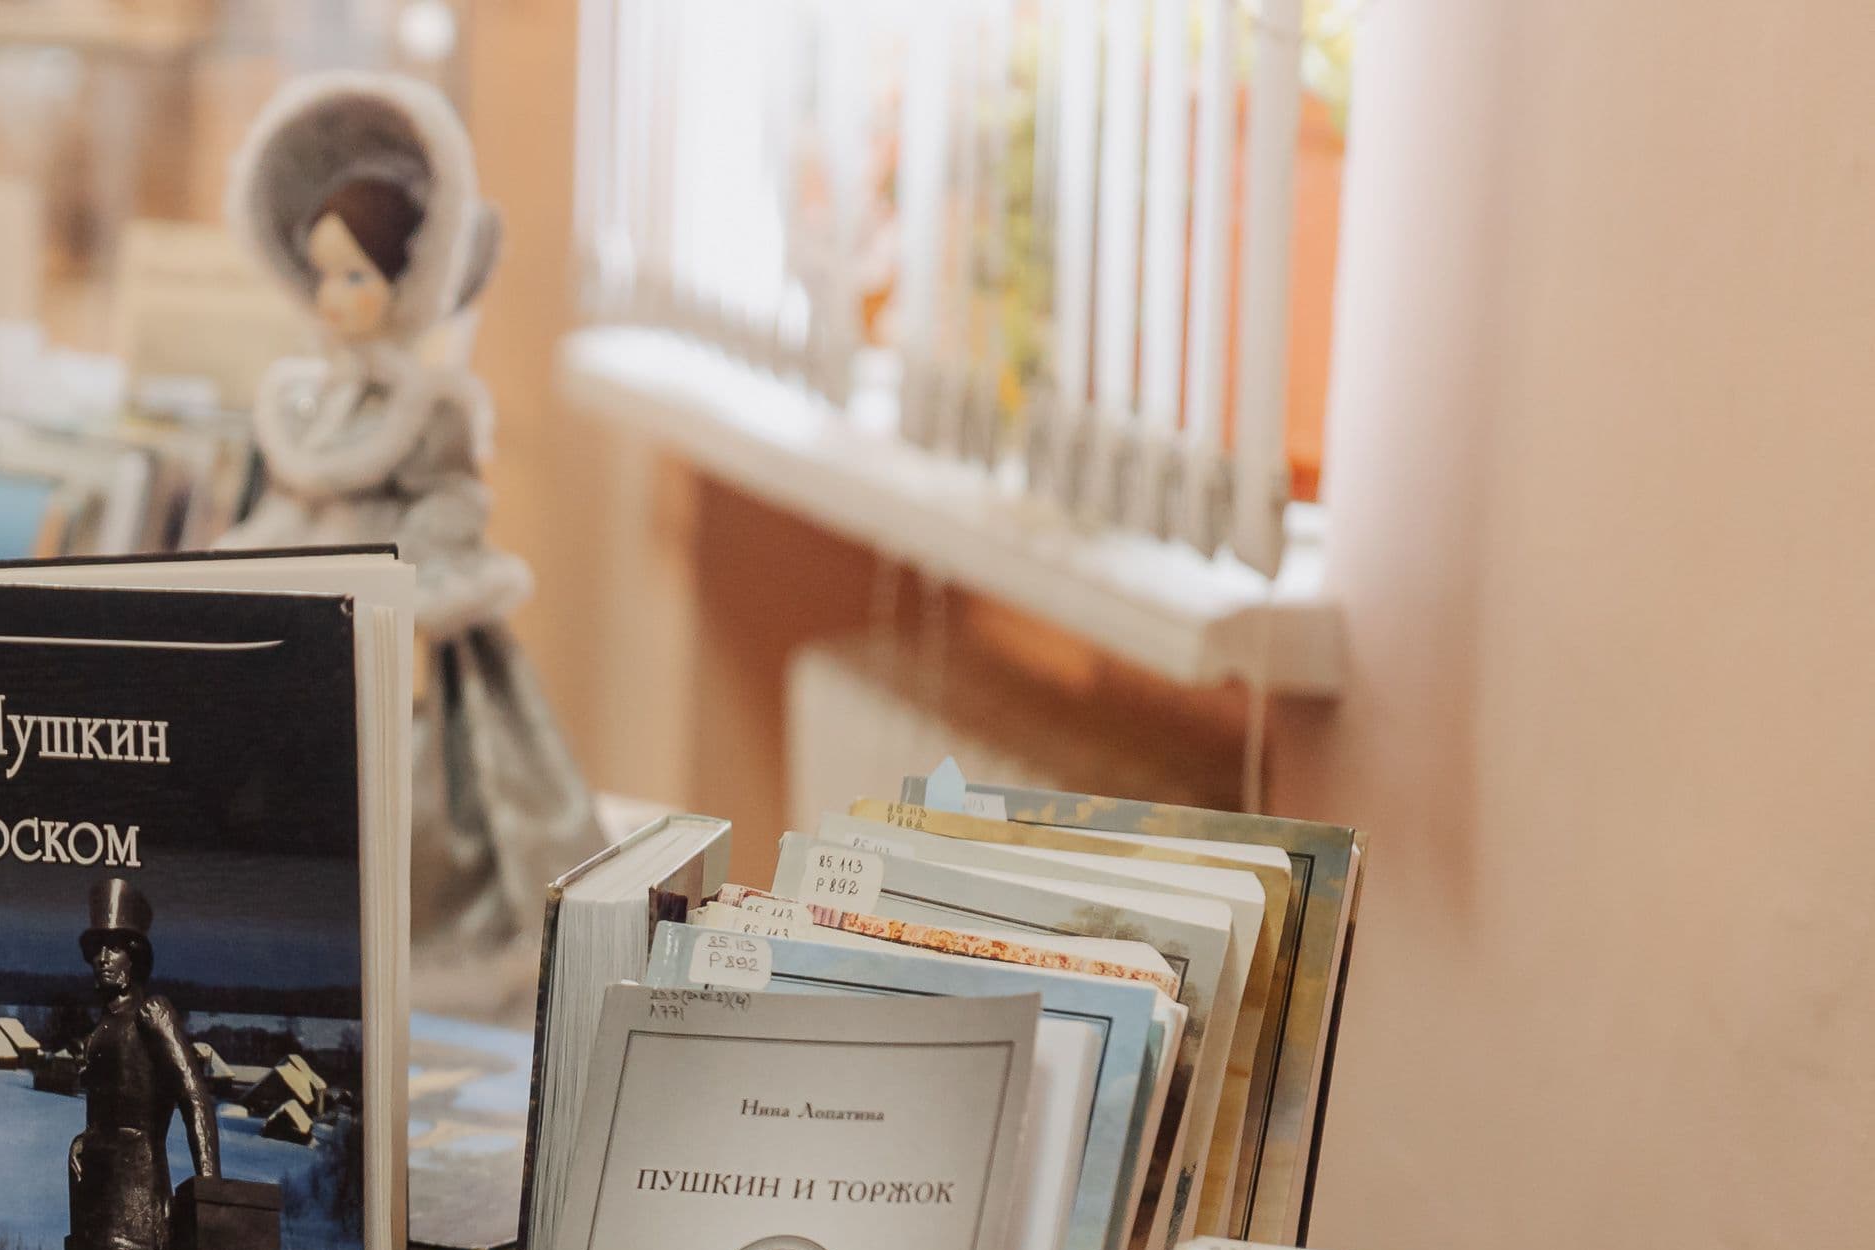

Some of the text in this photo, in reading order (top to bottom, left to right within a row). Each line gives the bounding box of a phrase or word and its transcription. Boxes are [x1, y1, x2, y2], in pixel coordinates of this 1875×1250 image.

[740, 1098, 886, 1123] Нина Лопатина
[635, 1167, 956, 1205] ПУШКИН И ТОРЖОК
